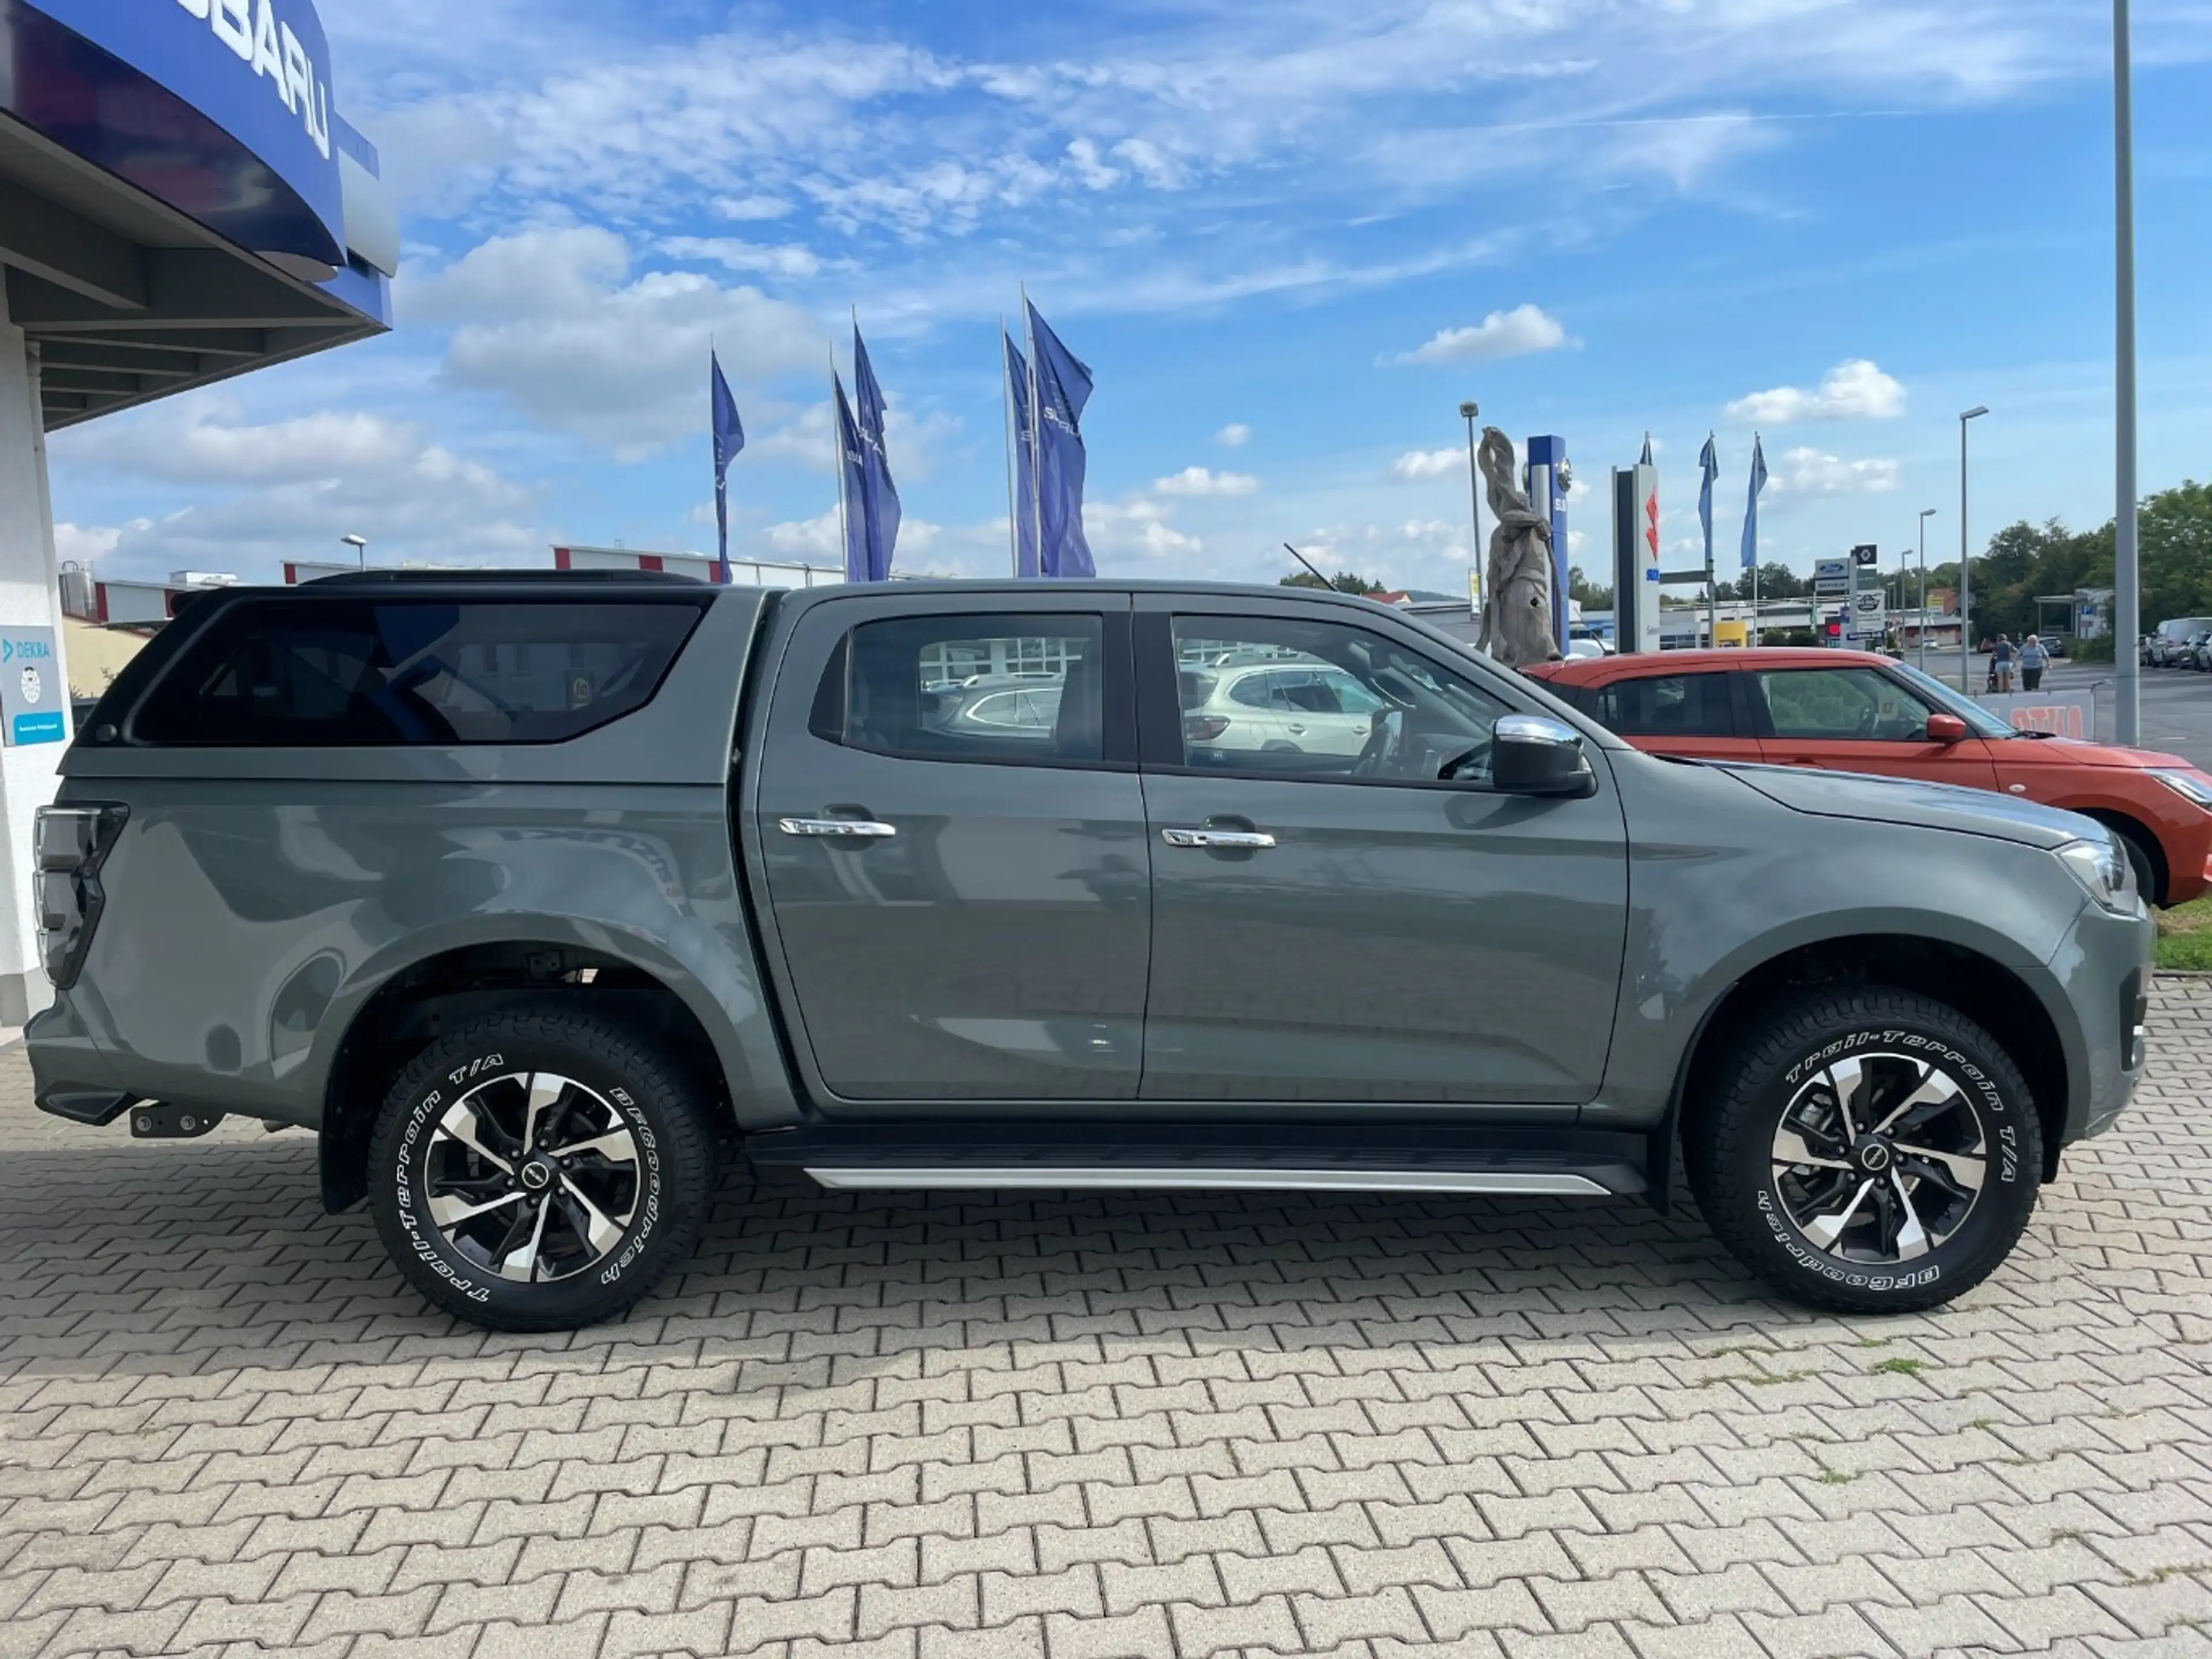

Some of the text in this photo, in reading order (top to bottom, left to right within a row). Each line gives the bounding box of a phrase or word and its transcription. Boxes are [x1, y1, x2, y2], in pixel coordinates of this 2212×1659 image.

[177, 0, 330, 160] BARU
[16, 641, 51, 658] DEKRA
[395, 1052, 504, 1303] Trail-Terrain T/A
[1785, 1029, 2017, 1183] Trail-Terrain T/A
[600, 1086, 662, 1285] BFGoodrich
[1757, 1190, 1939, 1291] BFGoodrich
